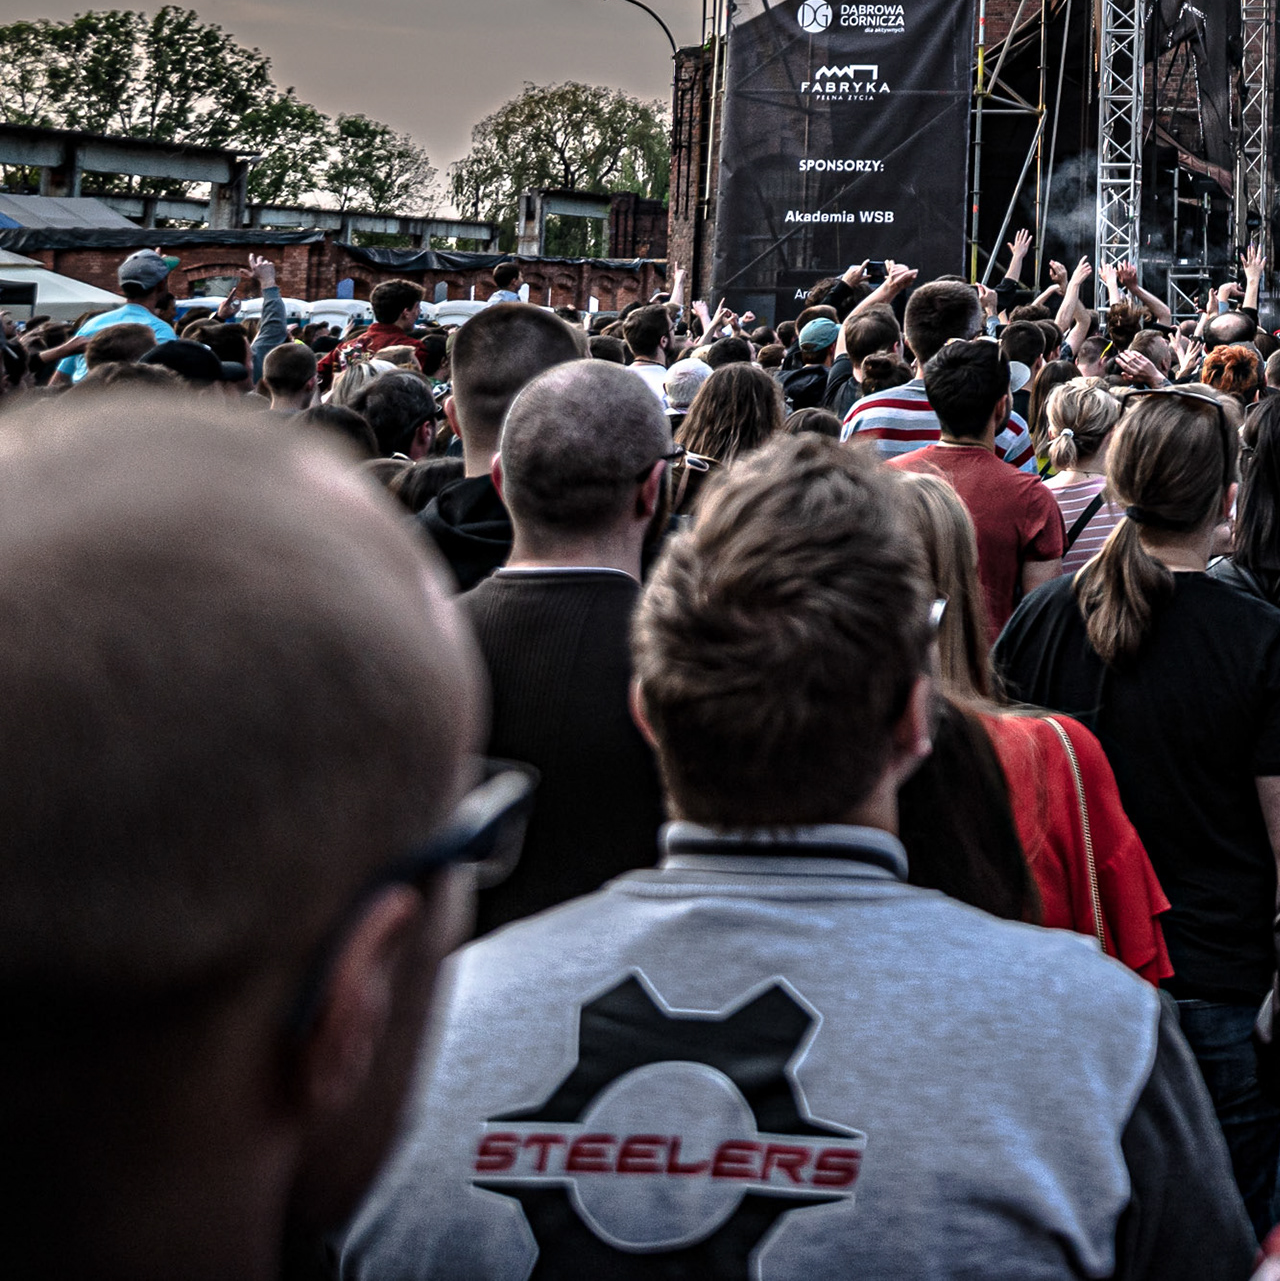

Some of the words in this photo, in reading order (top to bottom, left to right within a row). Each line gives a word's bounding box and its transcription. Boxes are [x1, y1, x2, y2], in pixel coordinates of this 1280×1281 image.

[840, 4, 905, 17] DĄBROWA
[801, 82, 891, 93] FABRYKA
[799, 159, 884, 172] SPONSORZY:
[785, 210, 855, 223] Akademia
[859, 211, 894, 223] WSB
[475, 1132, 863, 1188] STEELERS
